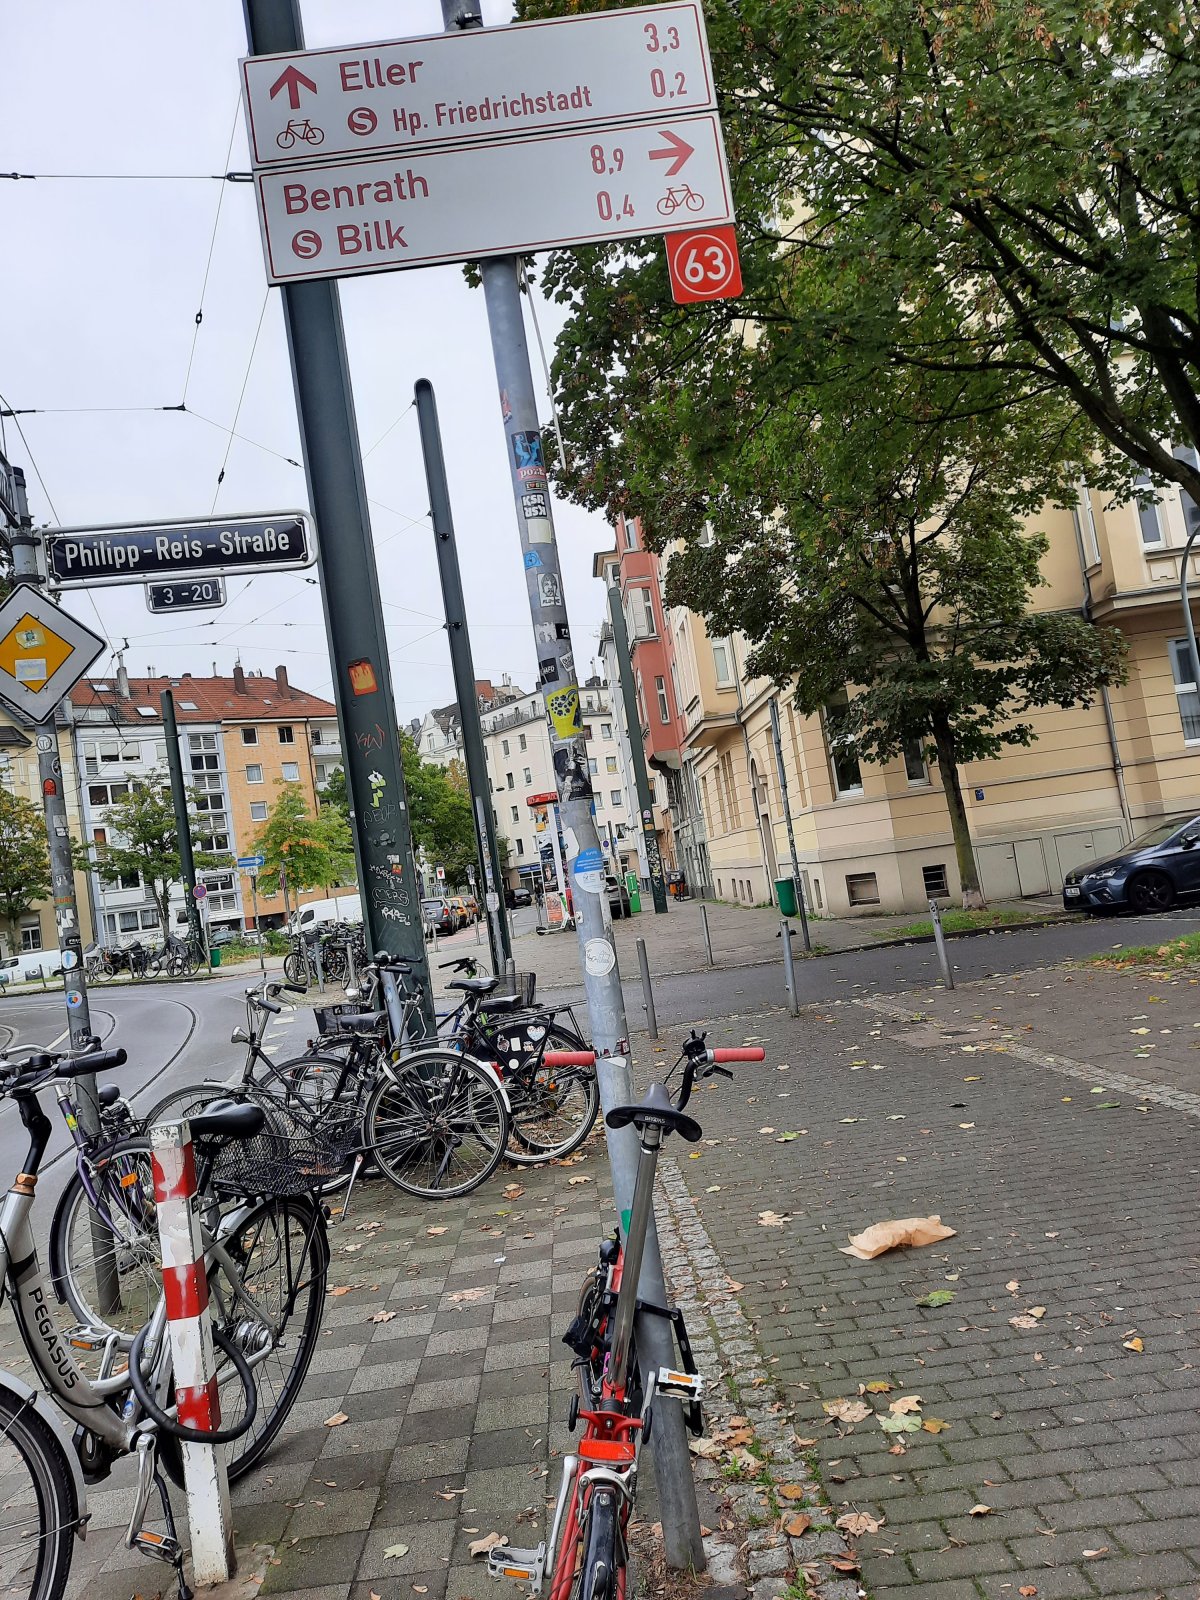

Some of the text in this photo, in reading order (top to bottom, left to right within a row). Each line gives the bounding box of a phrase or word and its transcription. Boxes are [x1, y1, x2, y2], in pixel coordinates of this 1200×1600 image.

[339, 22, 681, 93] Eller 3,3
[393, 108, 429, 137] Hp.
[435, 85, 593, 127] Friedrichstadt
[650, 68, 688, 99] 0,2
[283, 144, 625, 216] Benrath 8,9
[336, 219, 409, 257] Bilk
[596, 190, 635, 223] 0,4
[682, 245, 727, 284] 63
[522, 494, 545, 507] KSR
[64, 527, 290, 569] Philipp-Reis-Straße
[28, 1286, 80, 1389] PEGASUS
